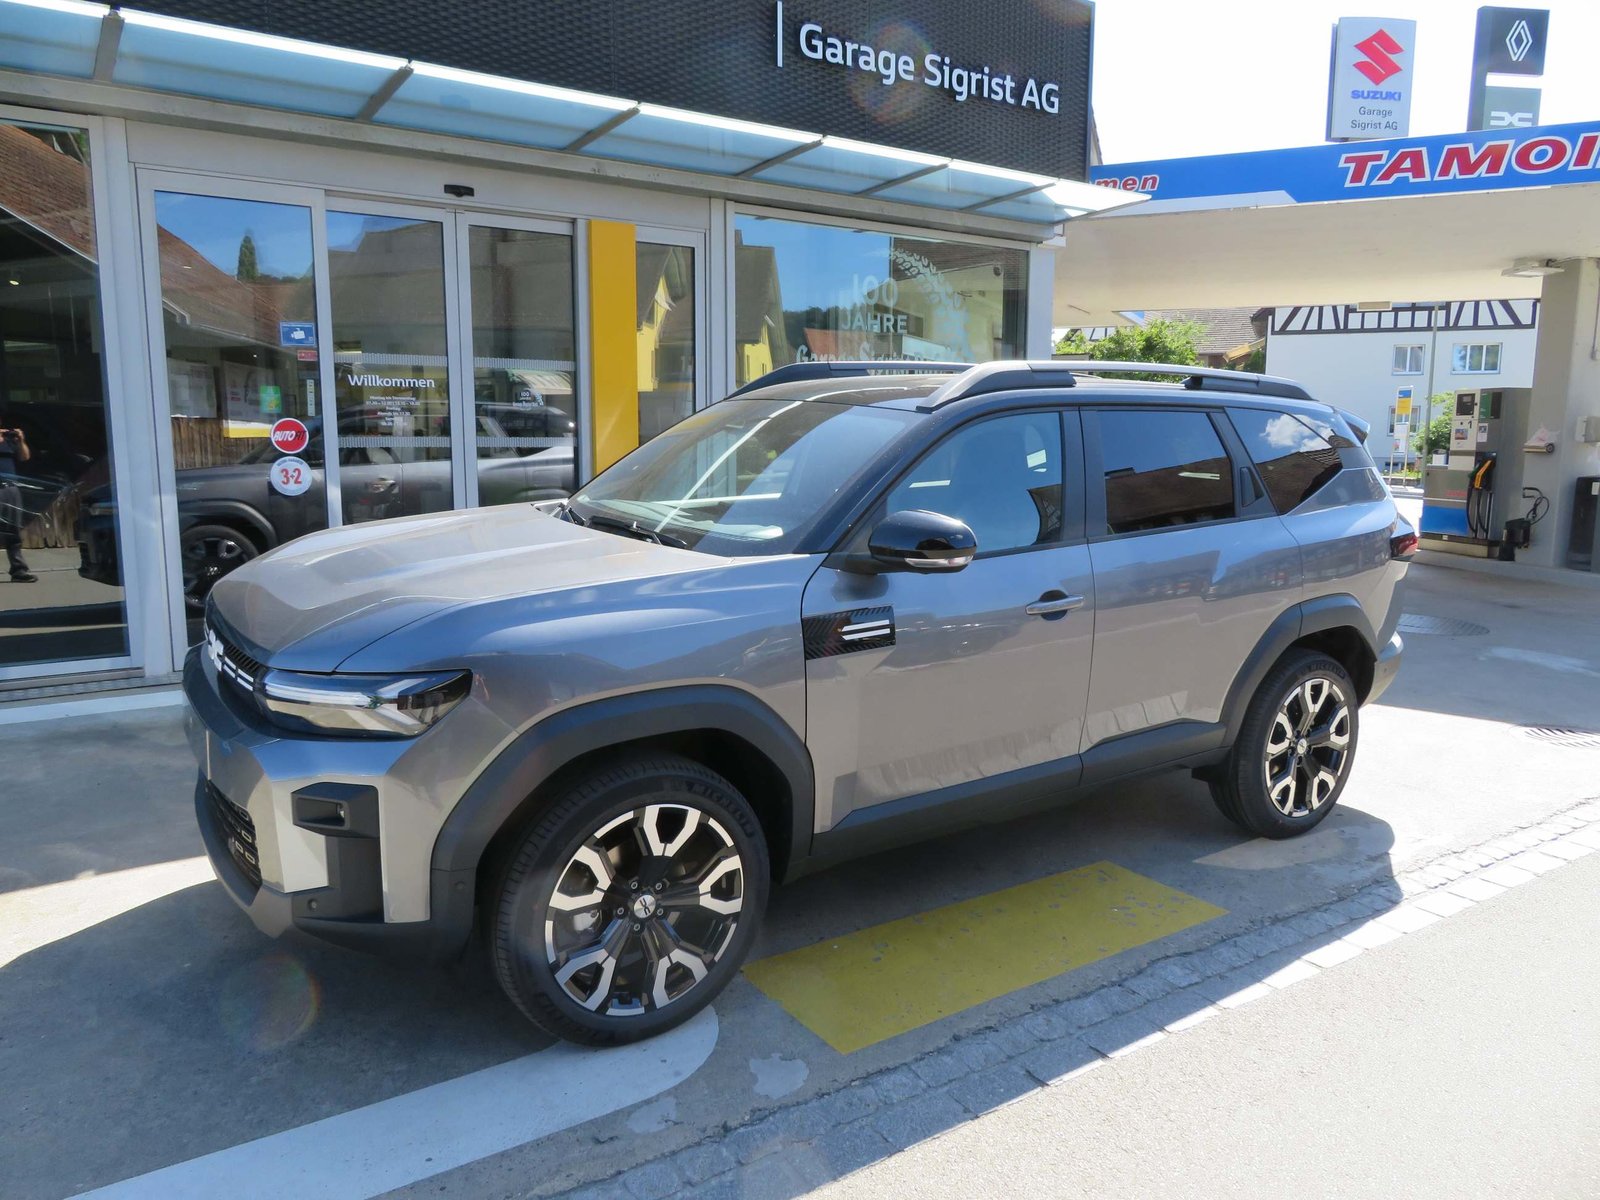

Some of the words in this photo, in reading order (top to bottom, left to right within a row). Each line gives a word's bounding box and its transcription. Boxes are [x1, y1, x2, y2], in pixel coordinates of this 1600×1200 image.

[799, 23, 915, 86] Garage
[924, 53, 1016, 104] Sigrist
[1021, 78, 1059, 114] AG
[1351, 90, 1402, 101] SUZUKI
[1359, 106, 1393, 118] Garage
[1350, 119, 1382, 131] Sigrist
[1384, 121, 1398, 130] AG
[1338, 132, 1600, 187] TAMOI
[841, 312, 908, 334] JAHRE
[347, 374, 435, 388] Willkommen
